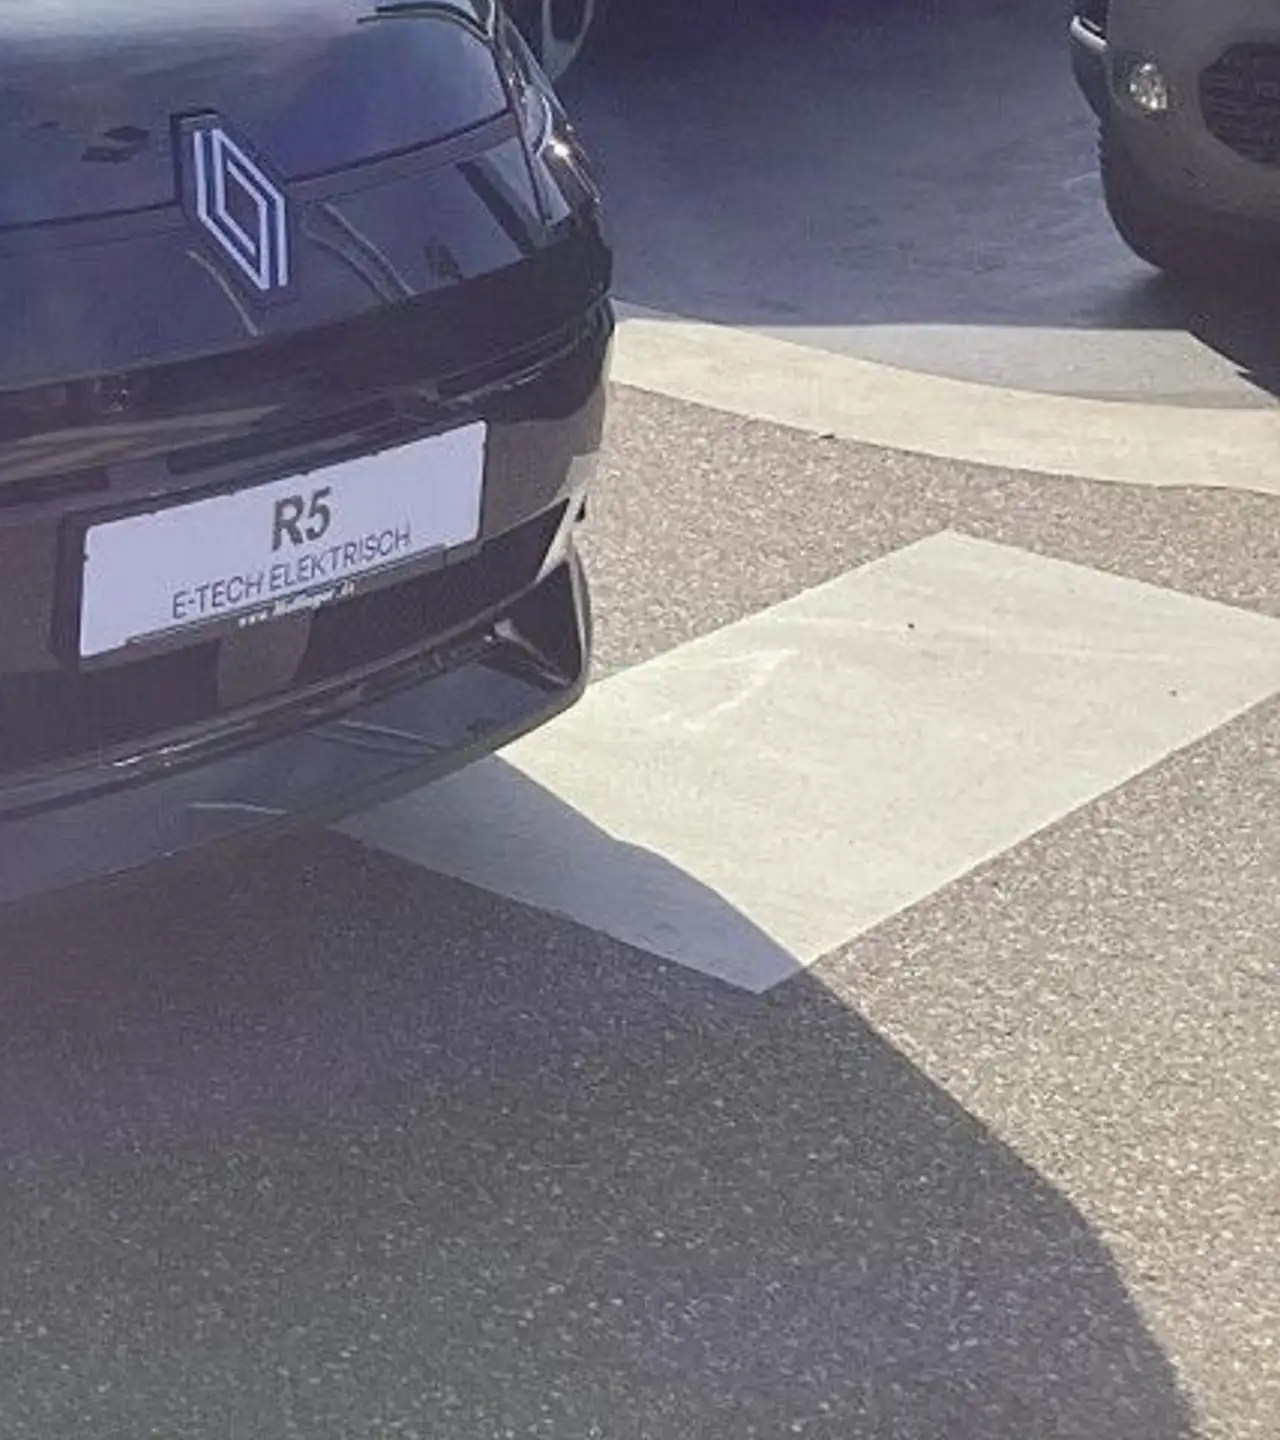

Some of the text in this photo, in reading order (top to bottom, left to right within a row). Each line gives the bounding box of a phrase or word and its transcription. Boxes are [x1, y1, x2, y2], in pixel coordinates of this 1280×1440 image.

[271, 486, 333, 551] R5
[173, 522, 412, 619] E-TECH ELEKTRISCH
